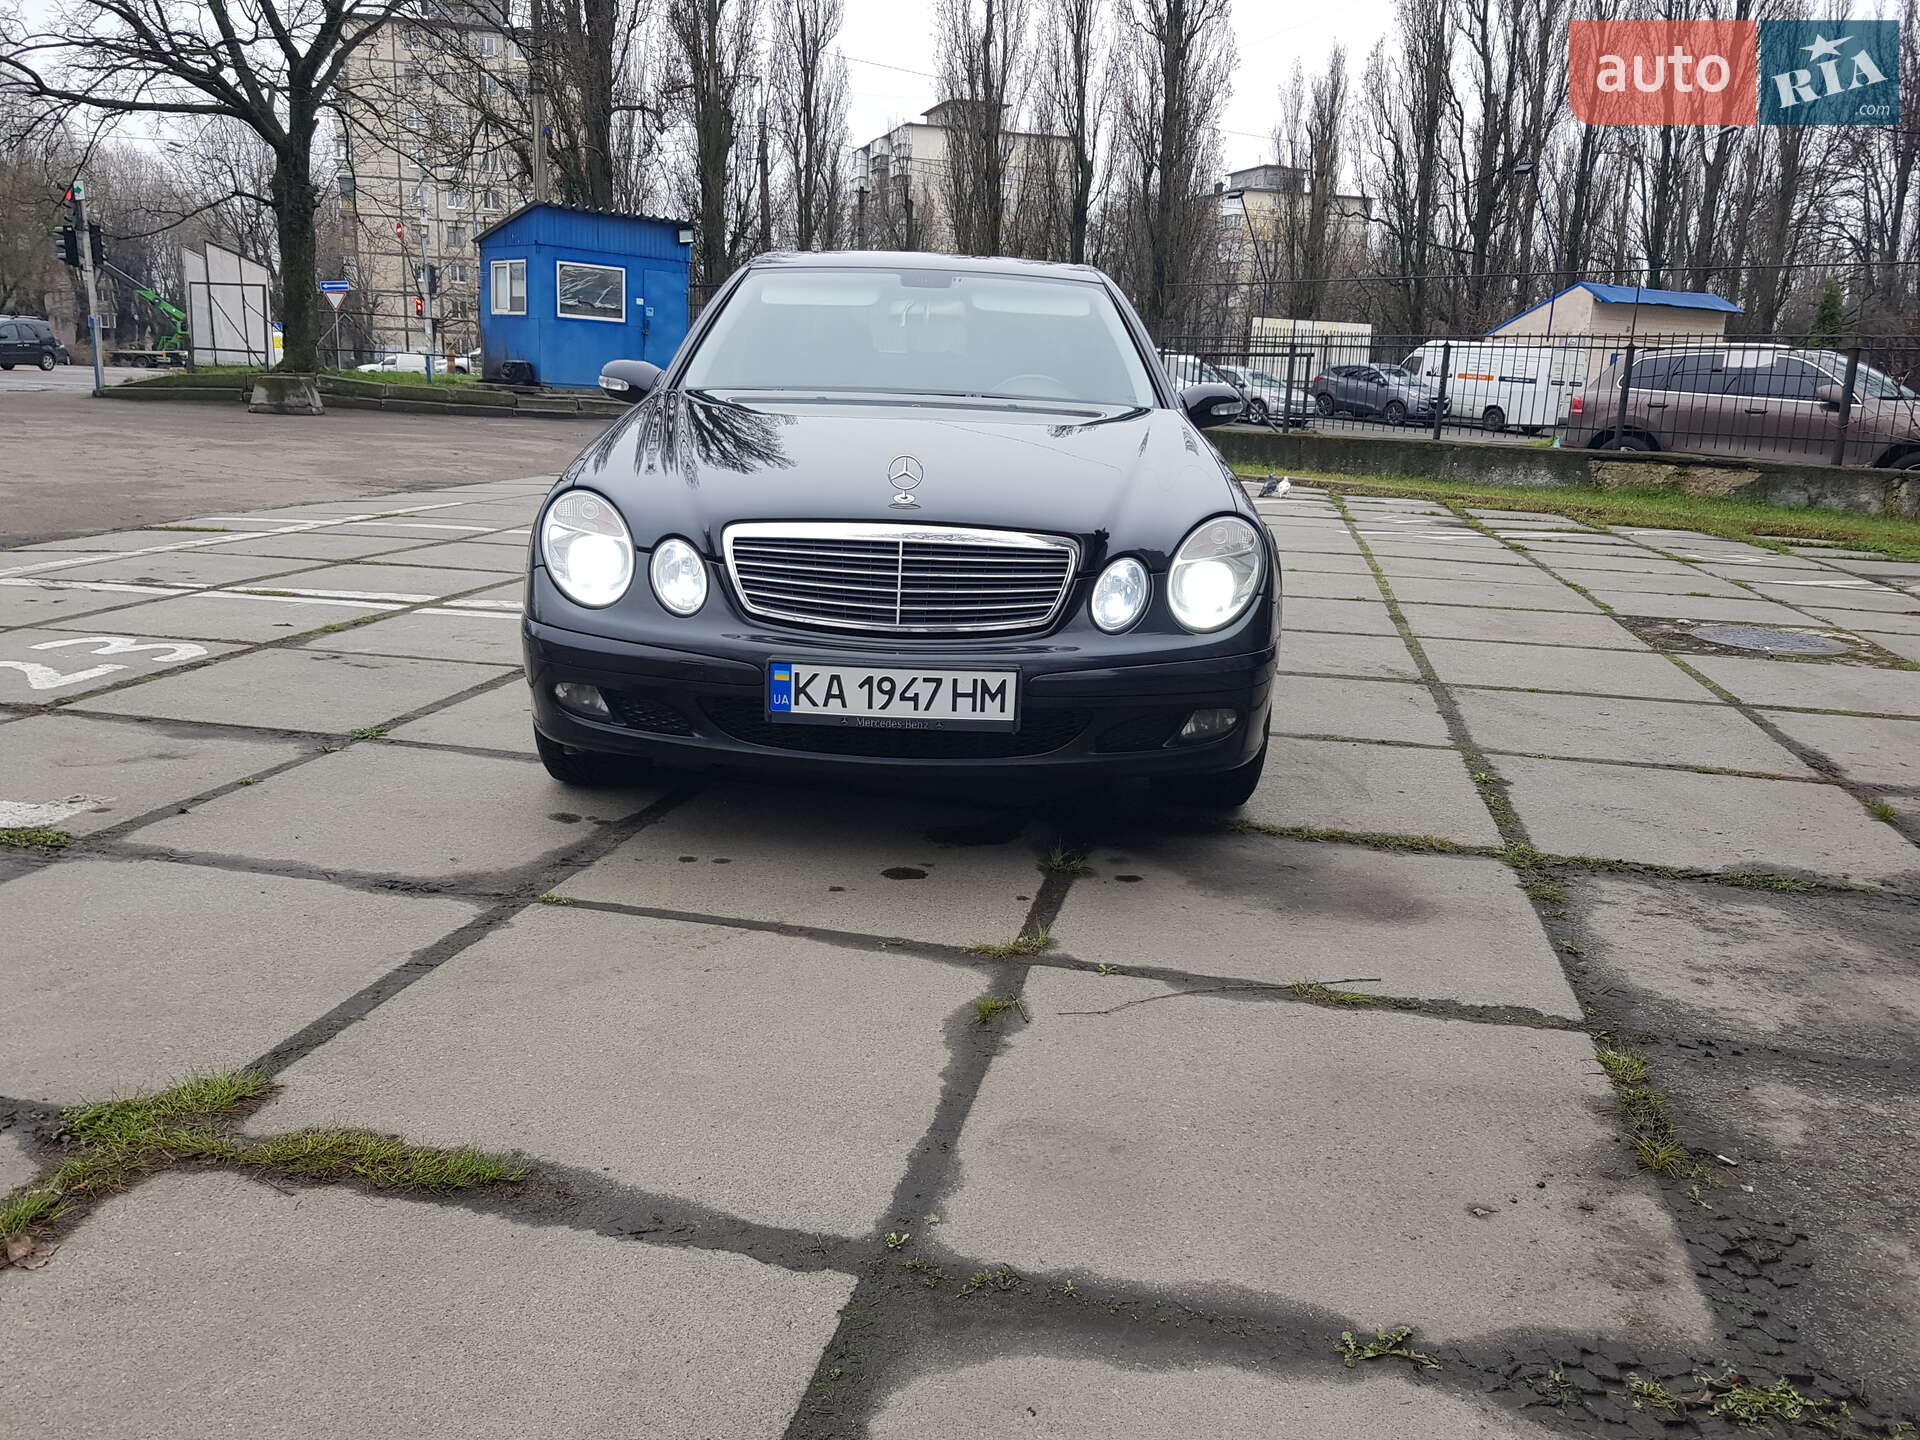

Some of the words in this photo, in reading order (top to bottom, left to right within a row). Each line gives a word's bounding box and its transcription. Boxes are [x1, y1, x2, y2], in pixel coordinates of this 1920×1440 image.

[794, 672, 848, 708] KA
[857, 675, 943, 711] 1947
[951, 678, 1007, 713] HM
[773, 694, 789, 705] UA
[856, 717, 928, 729] Mercedes-Benz
